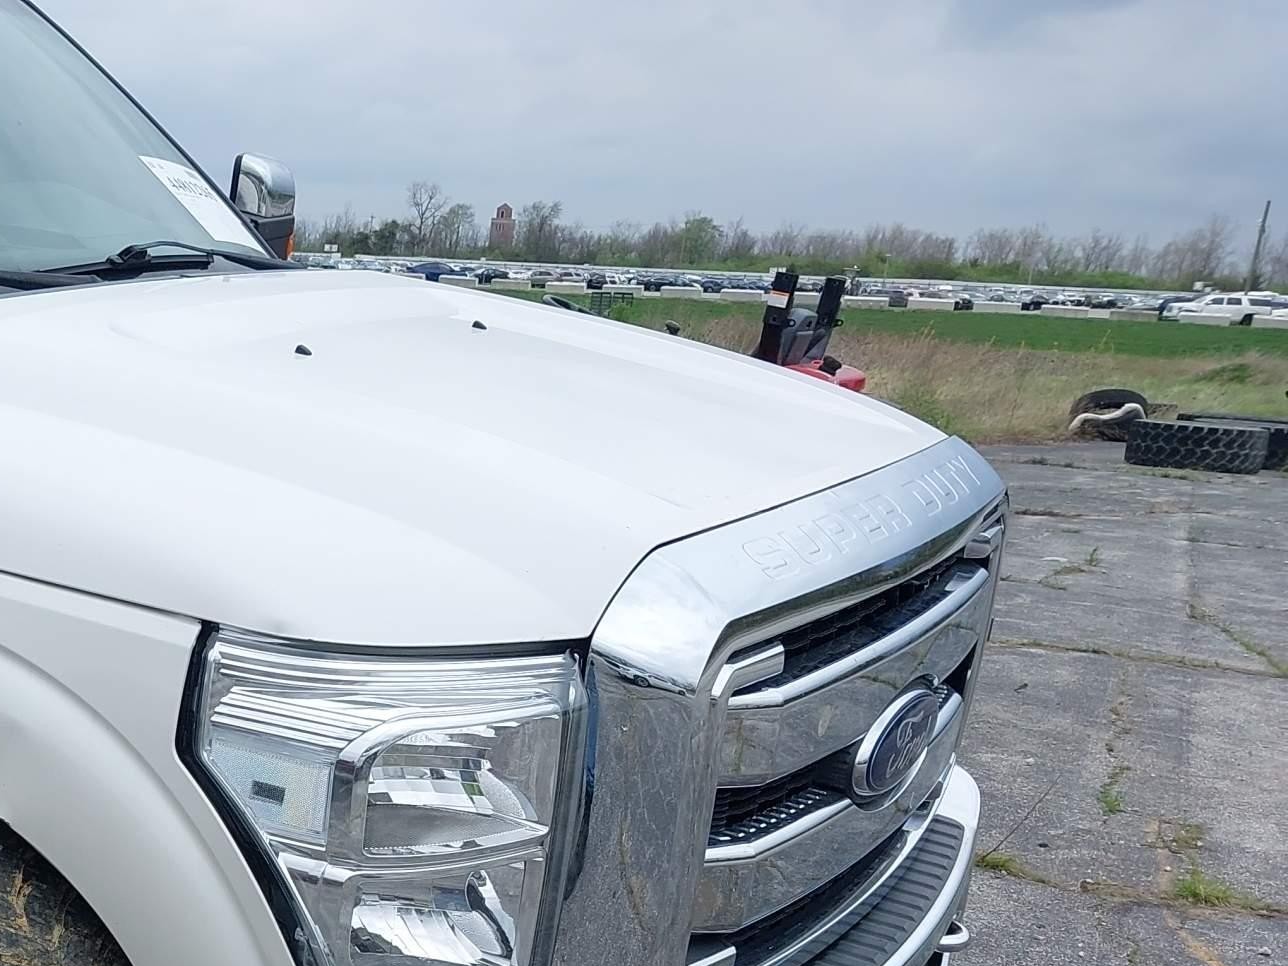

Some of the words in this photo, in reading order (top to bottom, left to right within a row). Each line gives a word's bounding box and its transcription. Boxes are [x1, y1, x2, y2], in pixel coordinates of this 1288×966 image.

[742, 493, 912, 581] SUPER
[902, 455, 981, 517] DUTY
[885, 709, 933, 779] Ford
